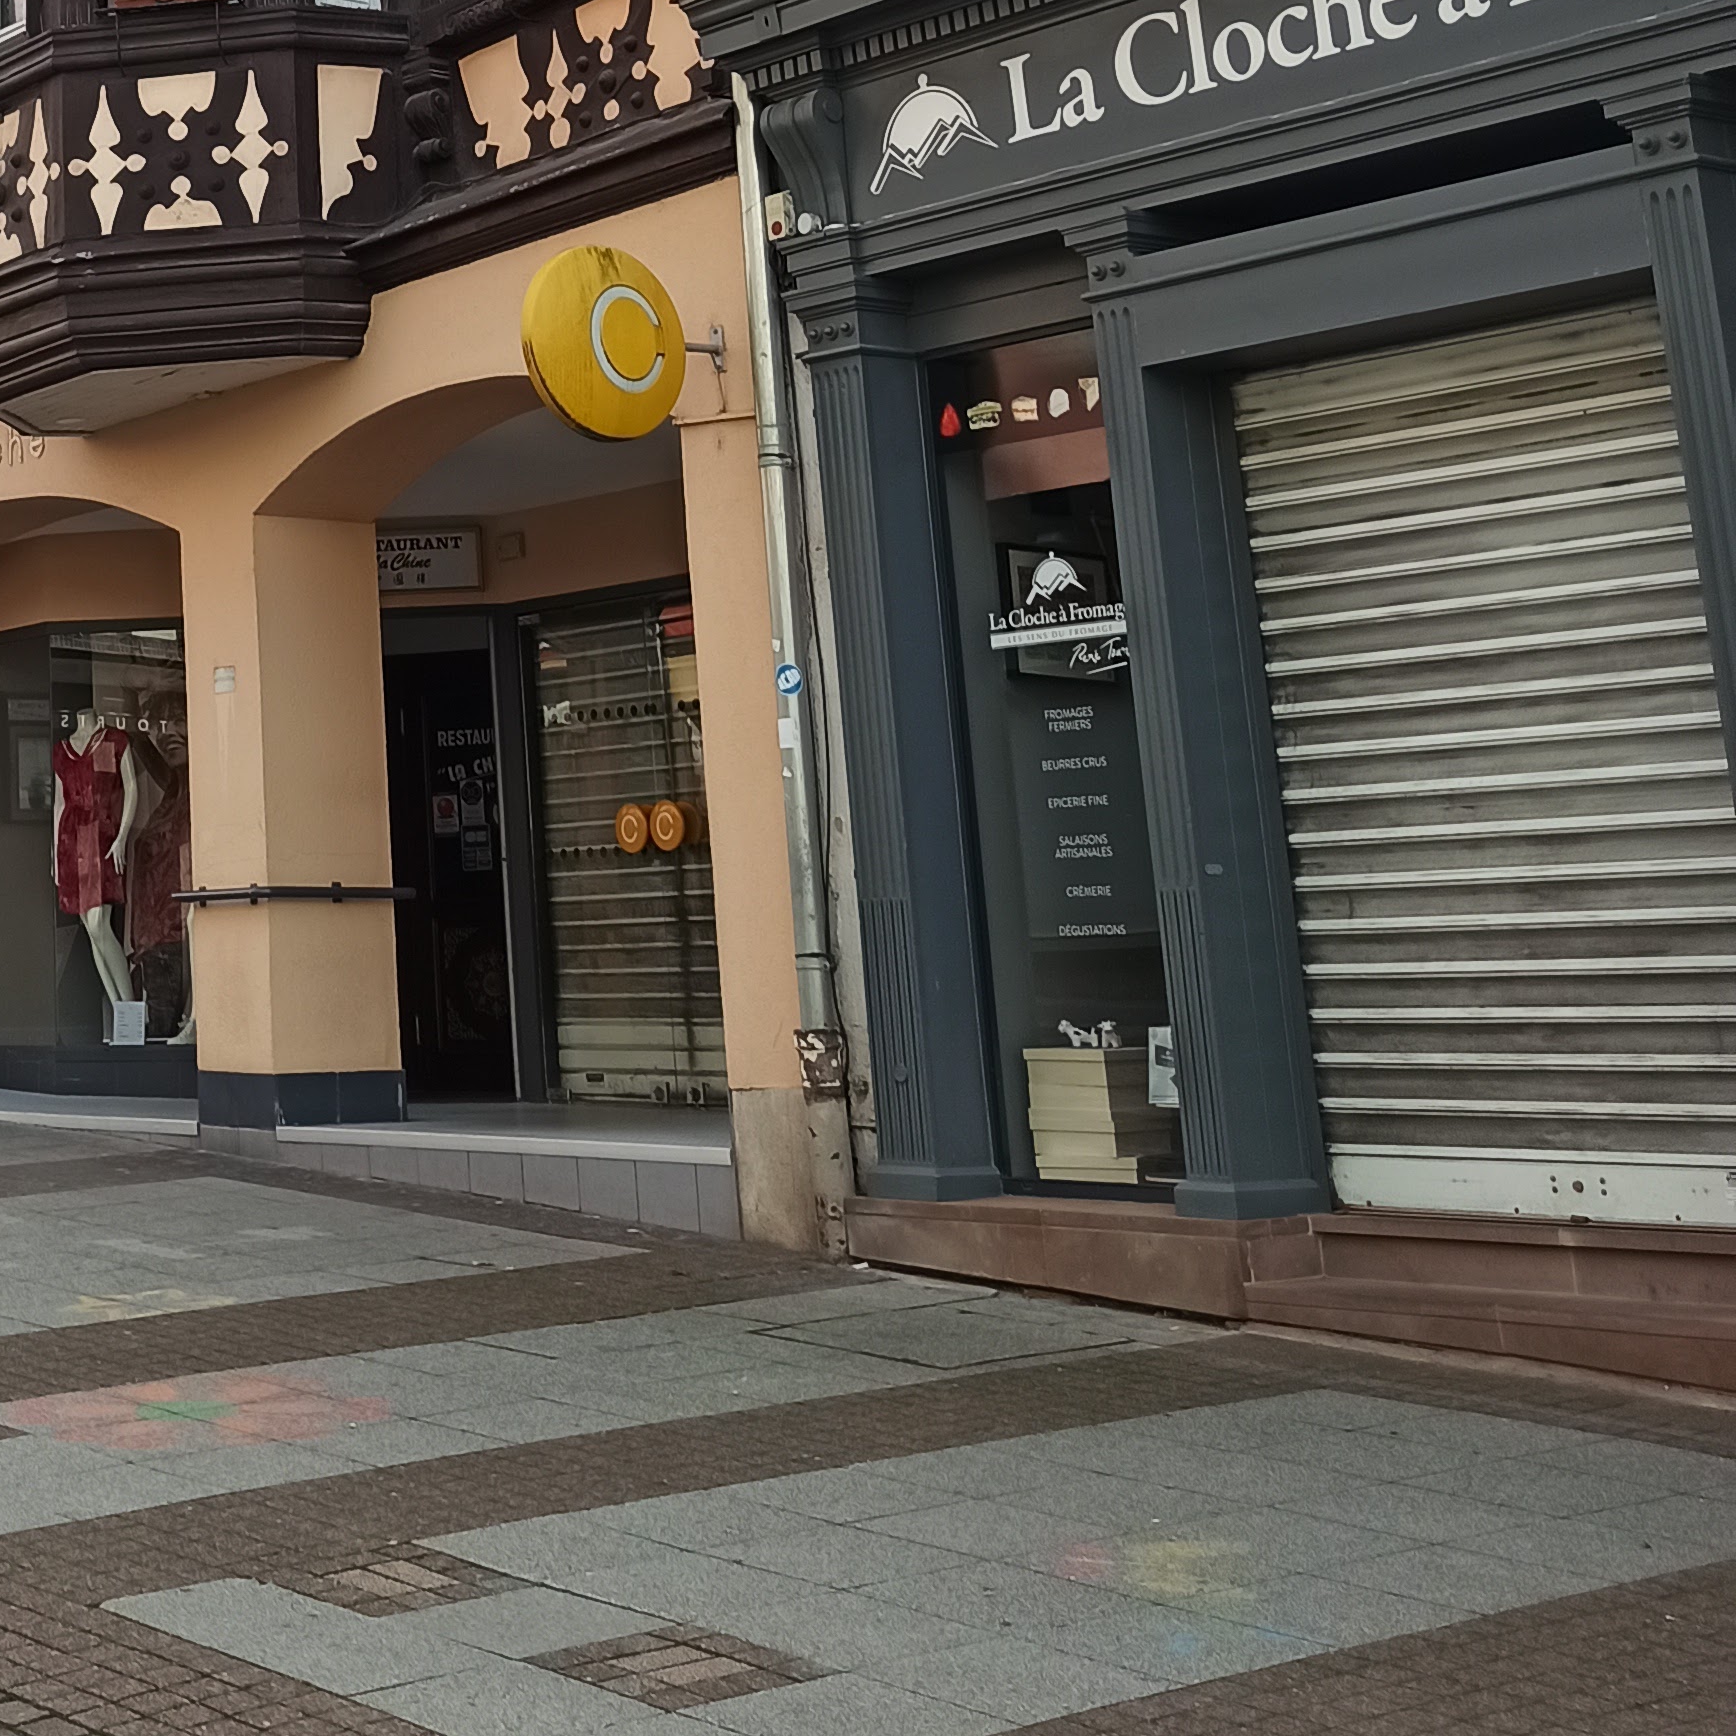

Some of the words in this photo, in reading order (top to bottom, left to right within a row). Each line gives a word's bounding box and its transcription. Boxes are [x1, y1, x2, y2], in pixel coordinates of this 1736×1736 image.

[1000, 52, 1104, 145] La
[390, 552, 431, 571] Chine
[988, 613, 1007, 631] La
[1008, 605, 1057, 628] Cloche
[1059, 604, 1068, 622] à
[1068, 602, 1126, 622] Fromag
[1007, 635, 1023, 644] LES
[1026, 632, 1049, 641] SENS
[1051, 630, 1065, 638] DU
[1068, 624, 1113, 637] FROMAGE
[1044, 706, 1094, 720] FROMAGES
[1048, 719, 1092, 733] FERMIERS
[437, 728, 495, 747] RESTAU
[1041, 758, 1082, 772] BEURRES
[1082, 756, 1108, 768] CRUS
[1087, 794, 1109, 807] FINE
[1058, 834, 1108, 847] SALAISONS
[1055, 846, 1114, 859] ARTISANALES
[1058, 924, 1127, 937] DÉGUSTATIONS
